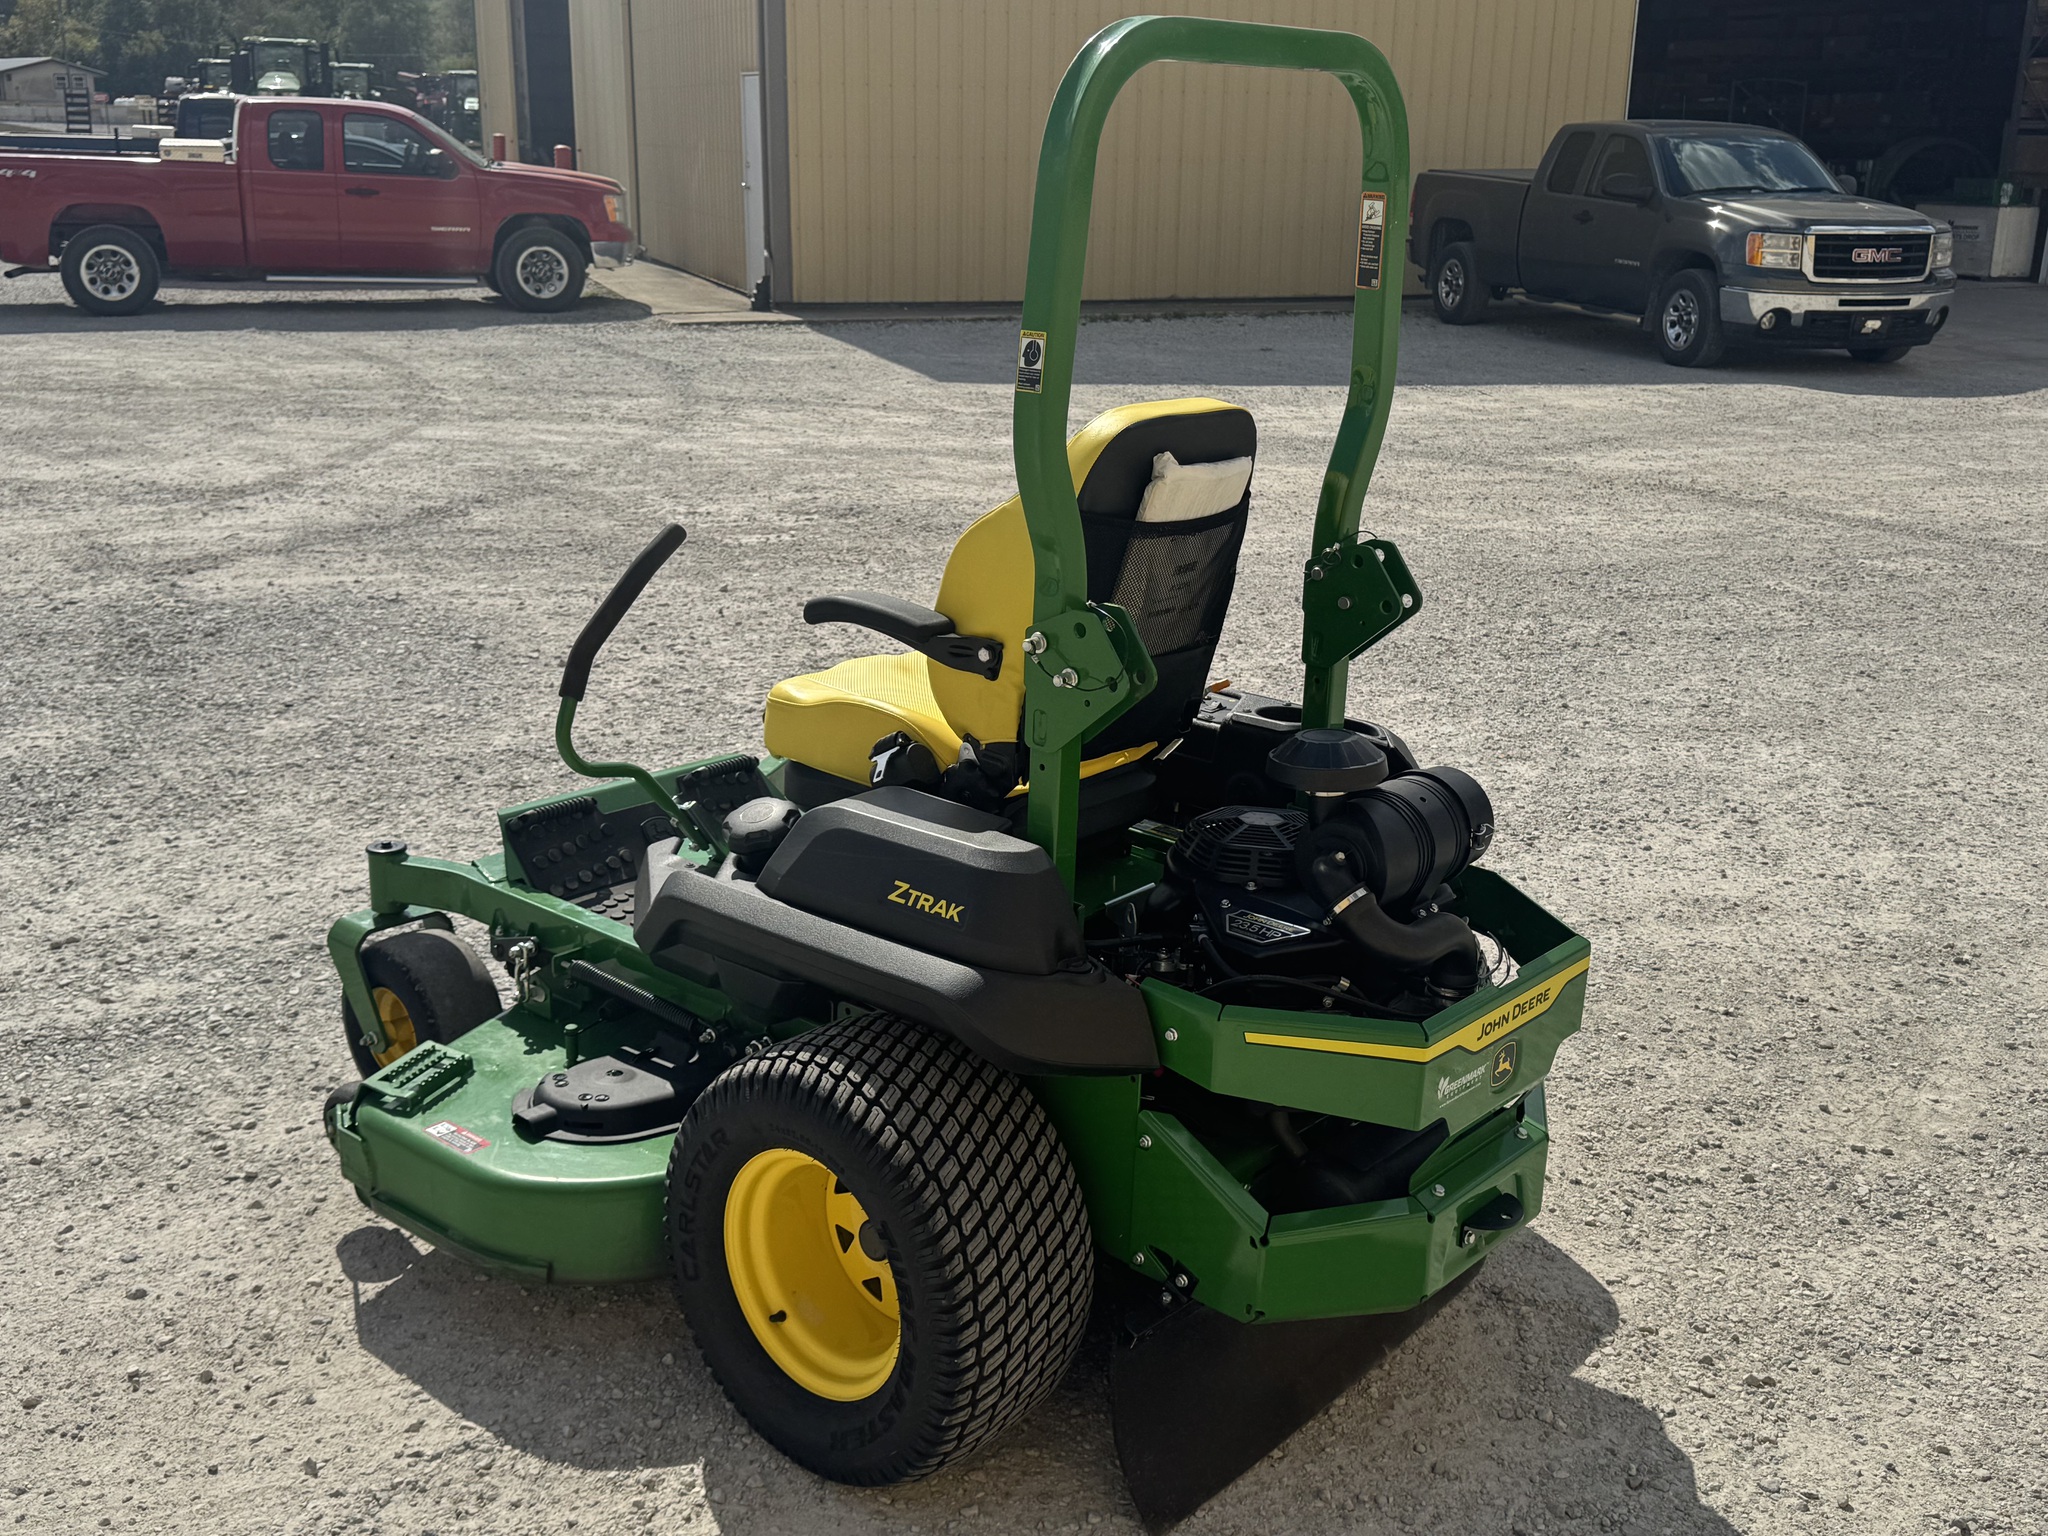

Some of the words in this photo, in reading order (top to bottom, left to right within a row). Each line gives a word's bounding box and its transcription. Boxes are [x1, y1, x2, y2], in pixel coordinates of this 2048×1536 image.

[1852, 247, 1902, 263] GMC
[1230, 918, 1259, 934] 23.5
[1258, 928, 1283, 940] HP
[1476, 1011, 1510, 1042] JOHN
[1511, 987, 1552, 1022] DEERE
